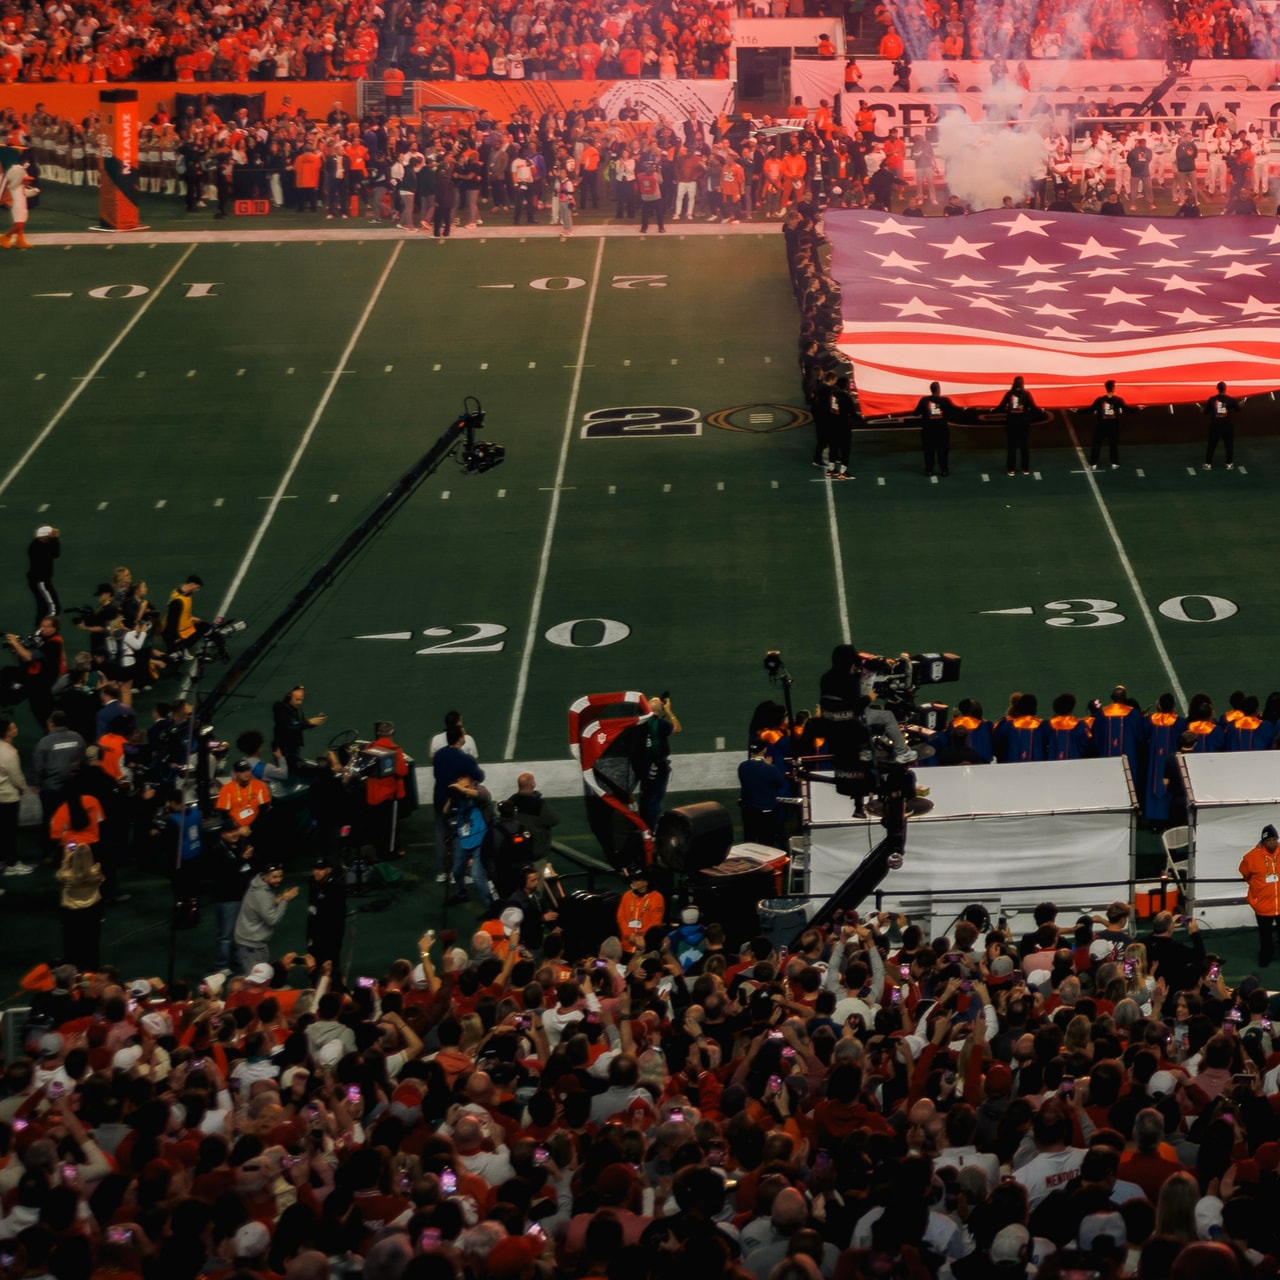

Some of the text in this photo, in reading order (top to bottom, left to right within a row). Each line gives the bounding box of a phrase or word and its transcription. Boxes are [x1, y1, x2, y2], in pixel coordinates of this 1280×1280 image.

[740, 35, 758, 44] 116
[122, 113, 132, 175] MIAMI
[1042, 594, 1240, 628] 30
[413, 616, 632, 655] 20
